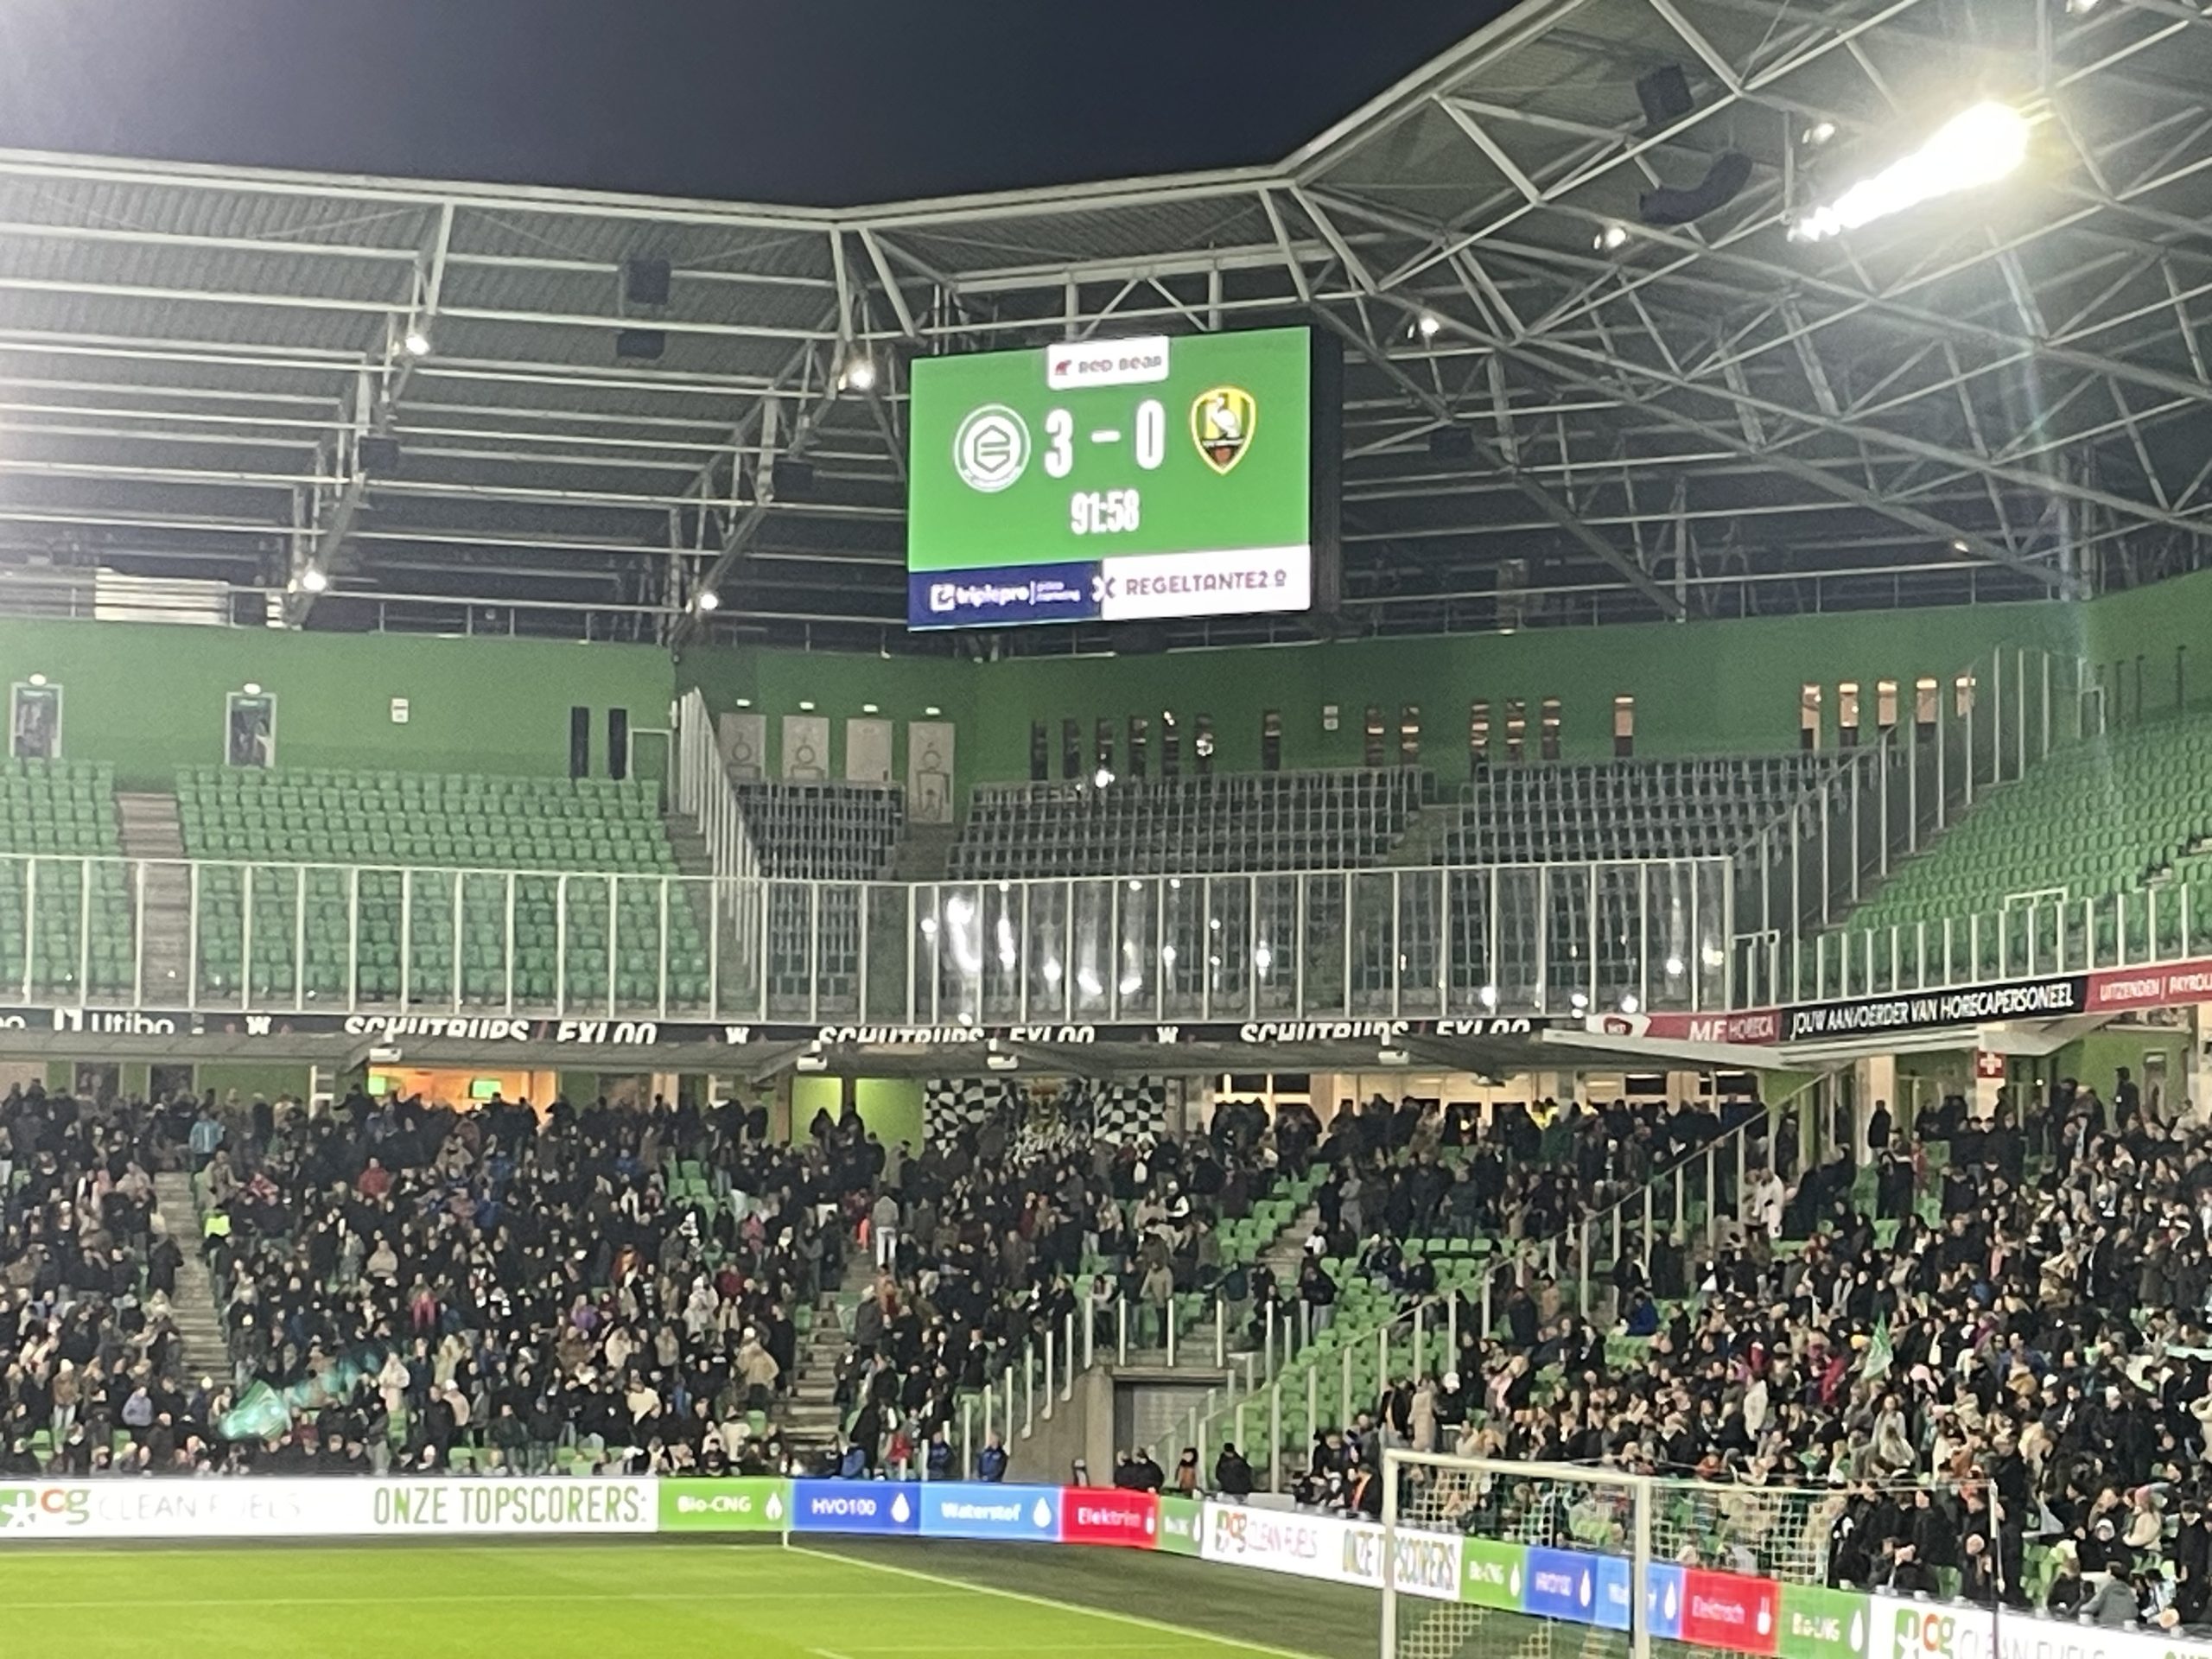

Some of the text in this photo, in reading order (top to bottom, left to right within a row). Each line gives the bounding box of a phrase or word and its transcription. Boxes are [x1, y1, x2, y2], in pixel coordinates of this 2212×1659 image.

[1044, 408, 1074, 479] 3
[1135, 398, 1166, 470] 0
[1069, 489, 1141, 537] 91:58
[1789, 982, 2075, 1040] JOUW AANVOERDER VAN HORECAPERSONEEL
[98, 1493, 197, 1521] CLEAN
[209, 1491, 302, 1521] FELS
[373, 1485, 448, 1525] ONZE
[677, 1495, 752, 1514] Bio-CNG
[811, 1497, 877, 1517] HVO100
